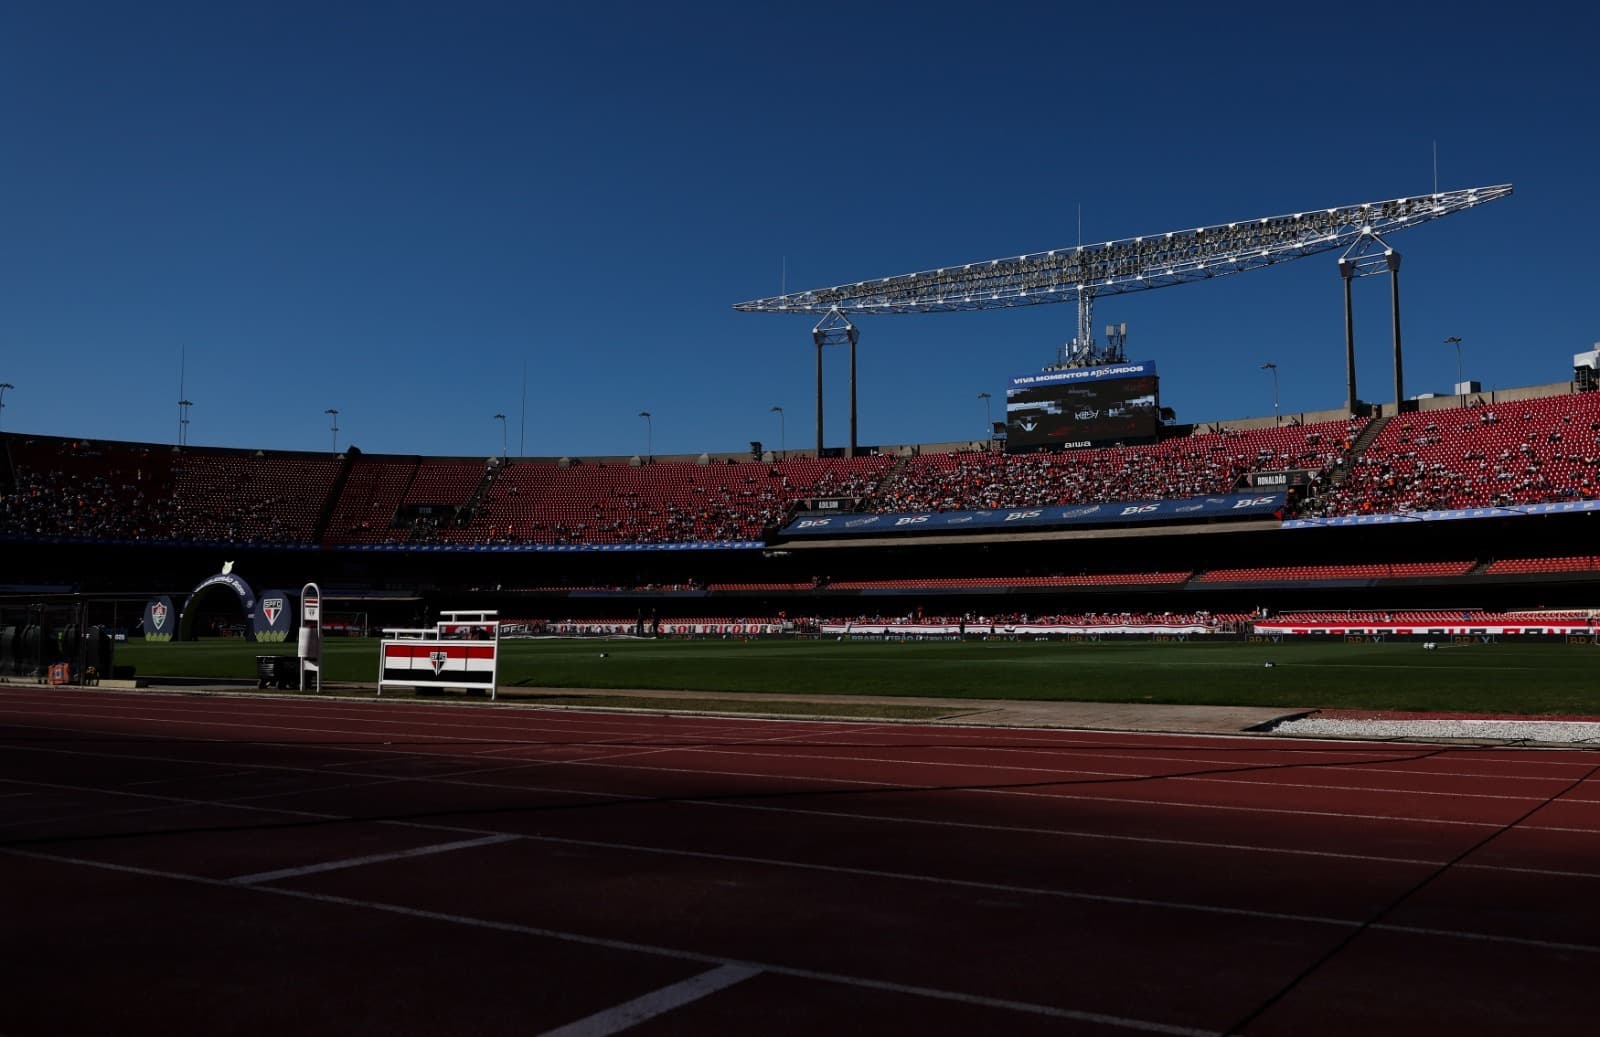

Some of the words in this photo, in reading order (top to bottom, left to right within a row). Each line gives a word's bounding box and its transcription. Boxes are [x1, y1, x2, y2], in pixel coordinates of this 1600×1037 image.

[1013, 376, 1035, 385] VIVA
[1035, 371, 1089, 382] MOMENTOS
[1064, 440, 1091, 449] aiwa
[1257, 474, 1287, 486] RONALDÃO
